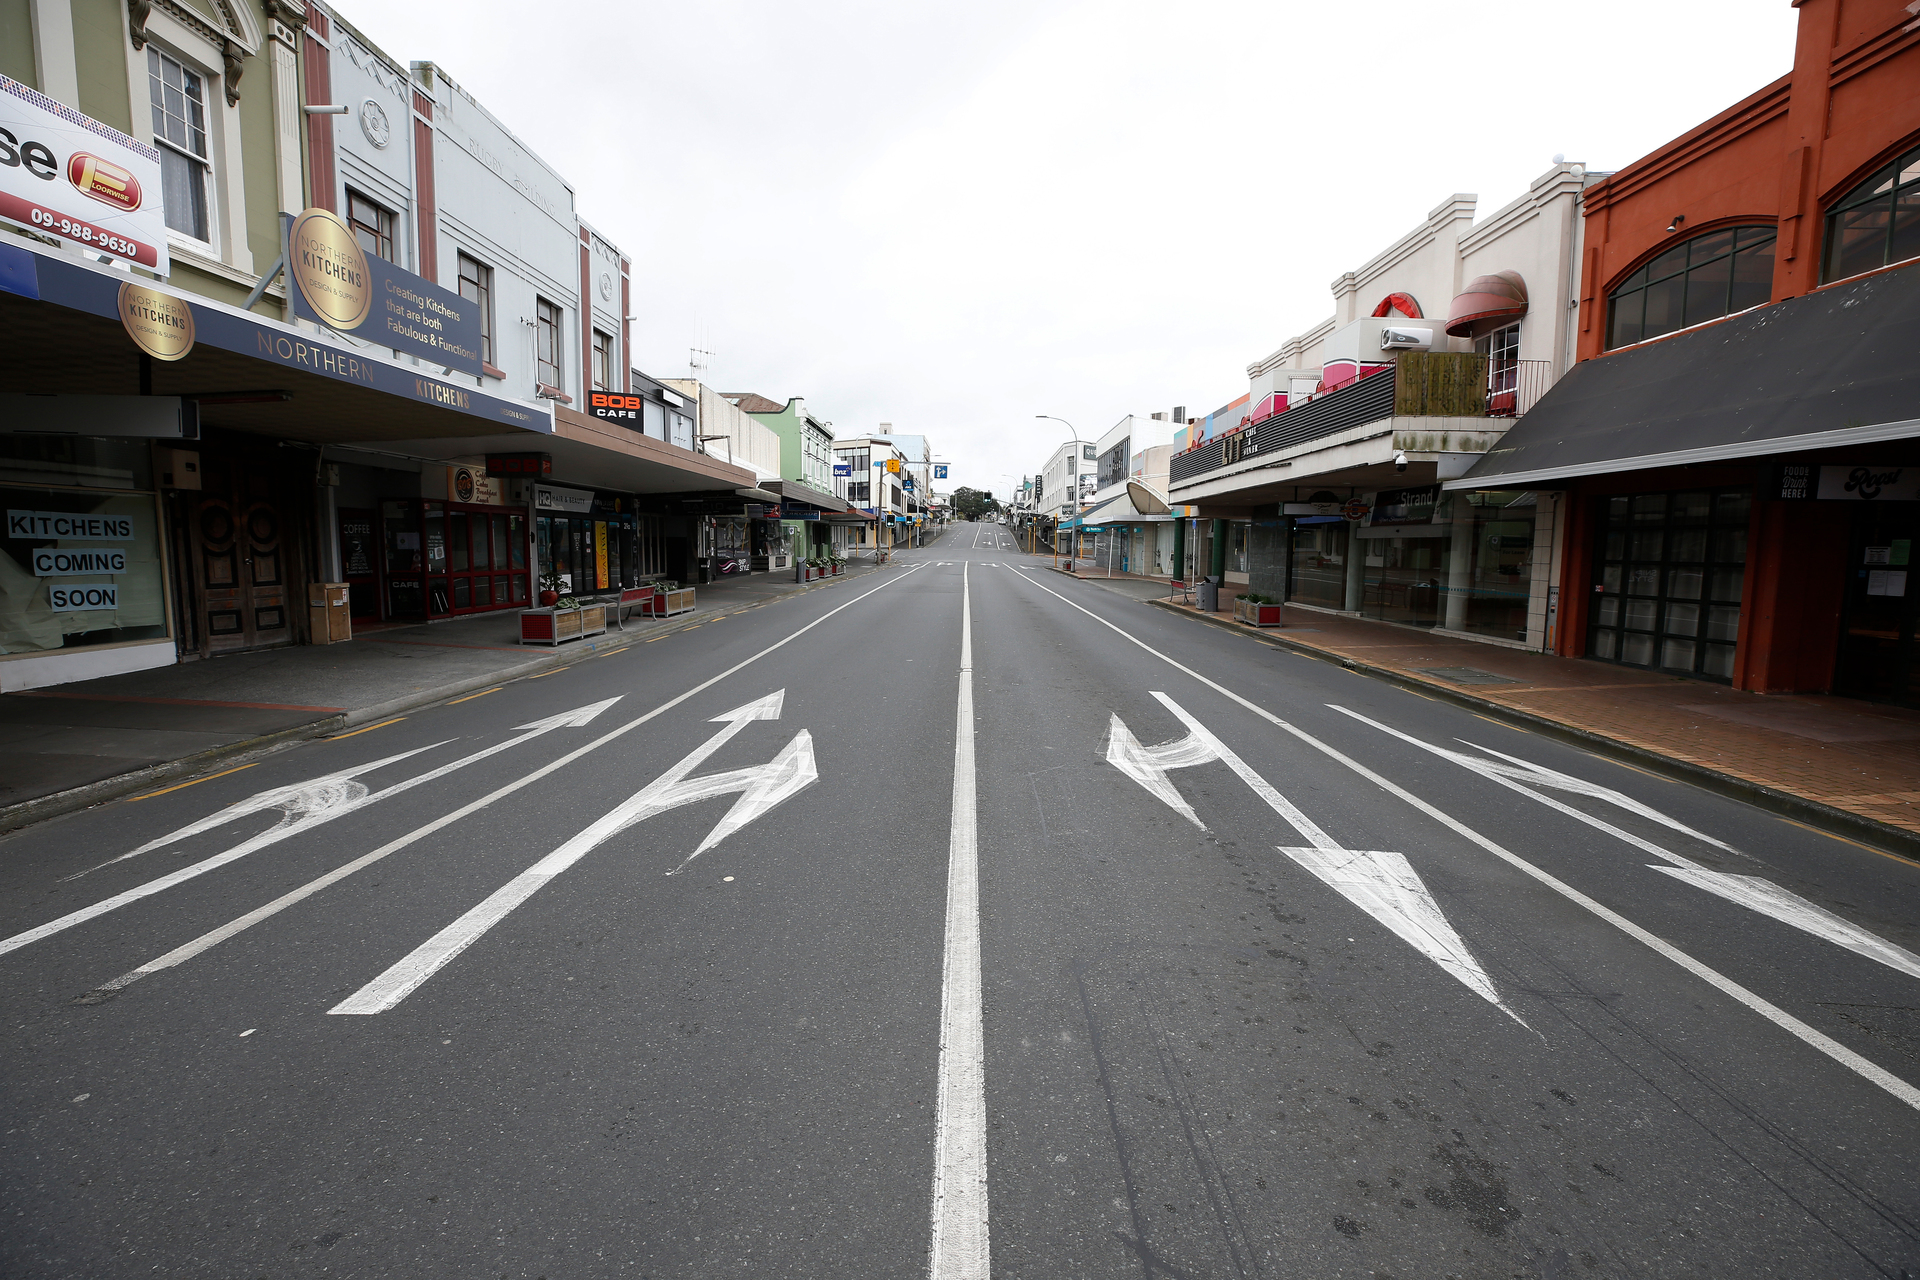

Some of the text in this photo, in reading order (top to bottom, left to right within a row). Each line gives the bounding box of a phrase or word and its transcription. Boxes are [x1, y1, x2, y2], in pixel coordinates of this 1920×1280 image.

[469, 136, 503, 175] RUGBY
[31, 208, 137, 257] 09-988-9630
[301, 235, 361, 270] NORTHERN
[302, 250, 362, 288] KITCHENS
[309, 279, 332, 293] DESIGN
[338, 292, 359, 303] SUPPLY
[385, 279, 461, 322] Creating Kitchens
[129, 293, 185, 317] NORTHERN
[386, 299, 443, 331] that are both
[129, 304, 186, 330] KITCHENS
[136, 325, 157, 336] DESIGN
[163, 332, 182, 341] SUPPLY
[387, 317, 477, 361] Fabulous & Functional
[257, 331, 374, 383] NORTHERN
[415, 379, 470, 409] KITCHENS
[592, 393, 640, 409] BOB
[596, 408, 636, 418] CAFE
[487, 458, 539, 473] BOB
[834, 467, 847, 475] bnz
[1782, 475, 1808, 488] Drink
[1844, 467, 1902, 499] Roost
[540, 492, 551, 505] HQ
[569, 496, 586, 505] BEAUTY
[1401, 488, 1433, 507] Strand
[1781, 489, 1802, 499] HERE
[10, 515, 130, 536] KITCHENS
[343, 524, 371, 534] COFFEE
[36, 554, 124, 571] COMING
[392, 581, 420, 589] CAFE
[53, 589, 115, 607] SOON
